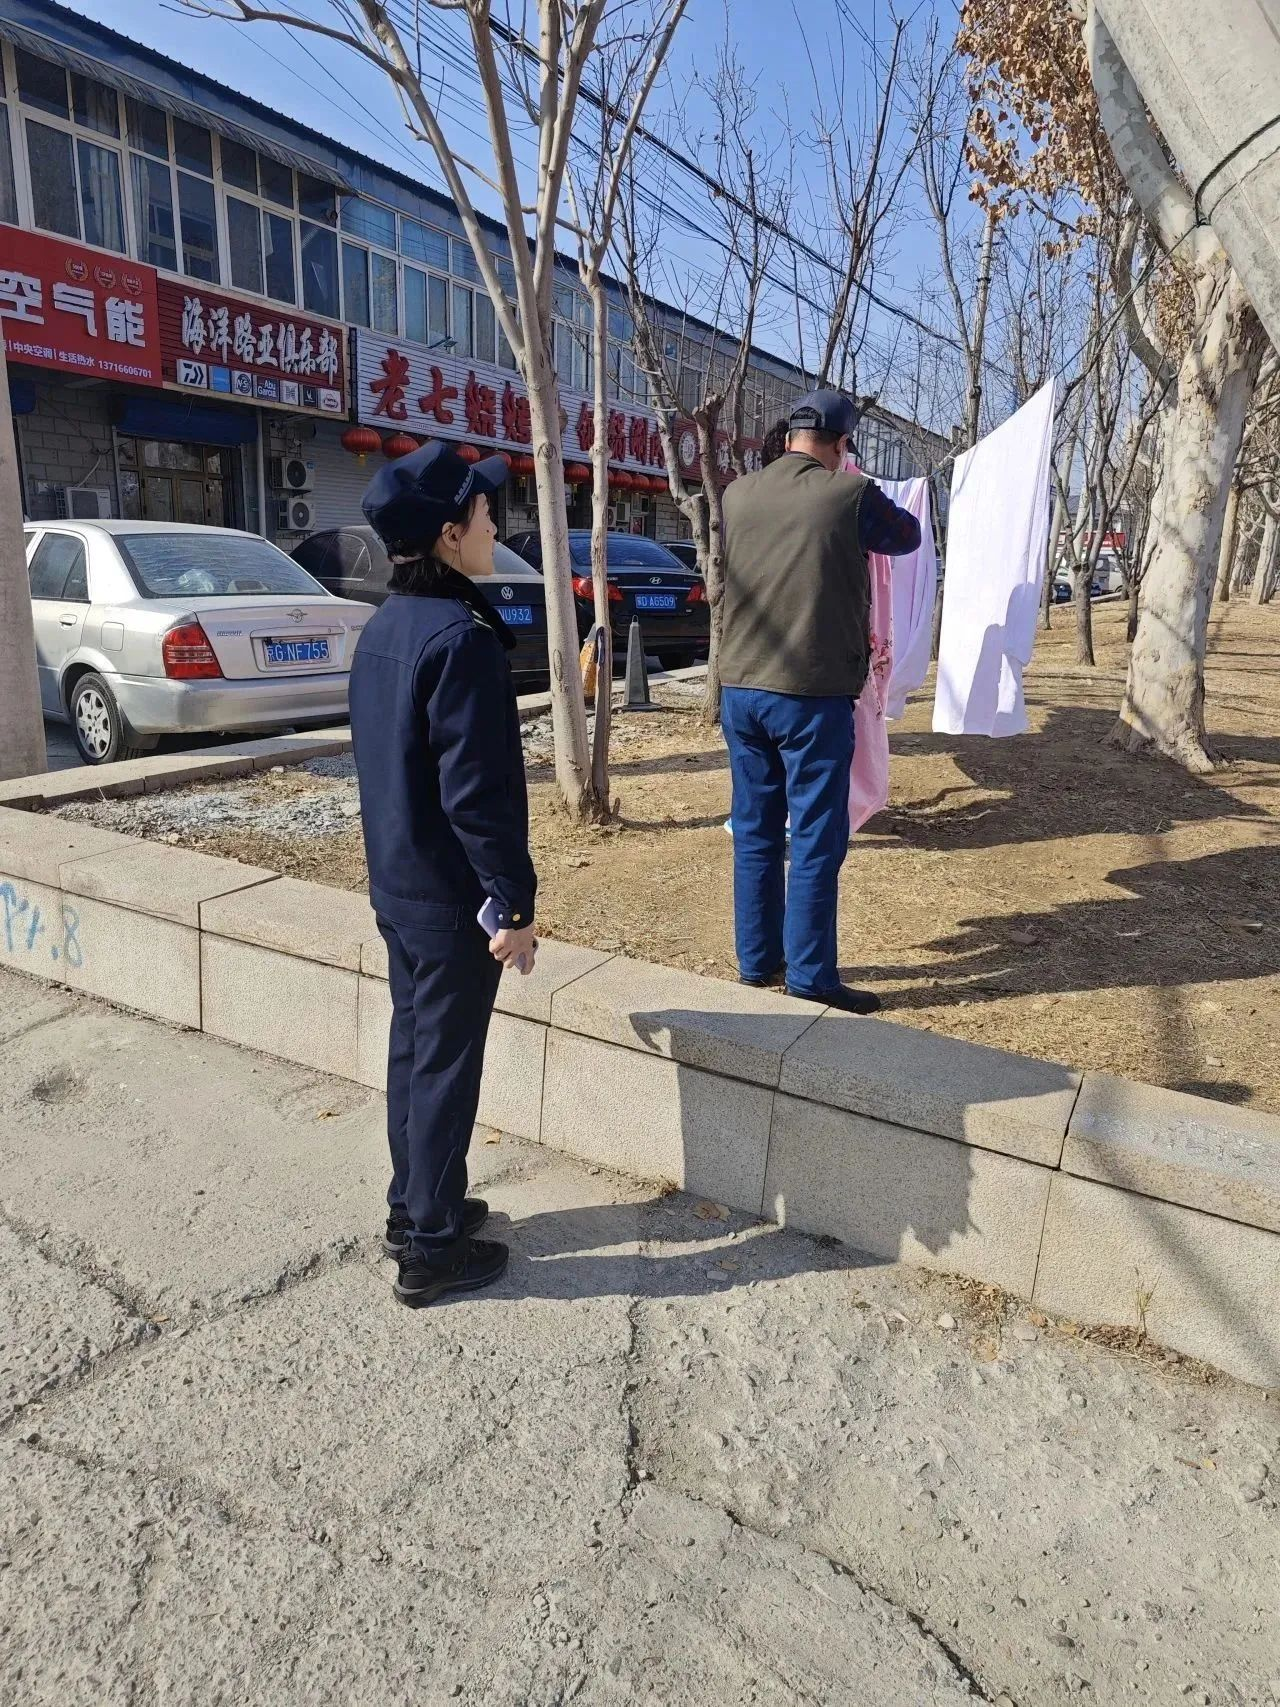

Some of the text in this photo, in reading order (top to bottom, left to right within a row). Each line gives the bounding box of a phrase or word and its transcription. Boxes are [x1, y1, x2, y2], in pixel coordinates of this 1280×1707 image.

[0, 270, 145, 347] 空气能
[182, 295, 338, 385] 海洋路亚俱乐部
[13, 341, 53, 359] 中央空调
[59, 351, 95, 366] 生活热水
[257, 385, 277, 398] Garcia
[264, 379, 276, 390] Abu
